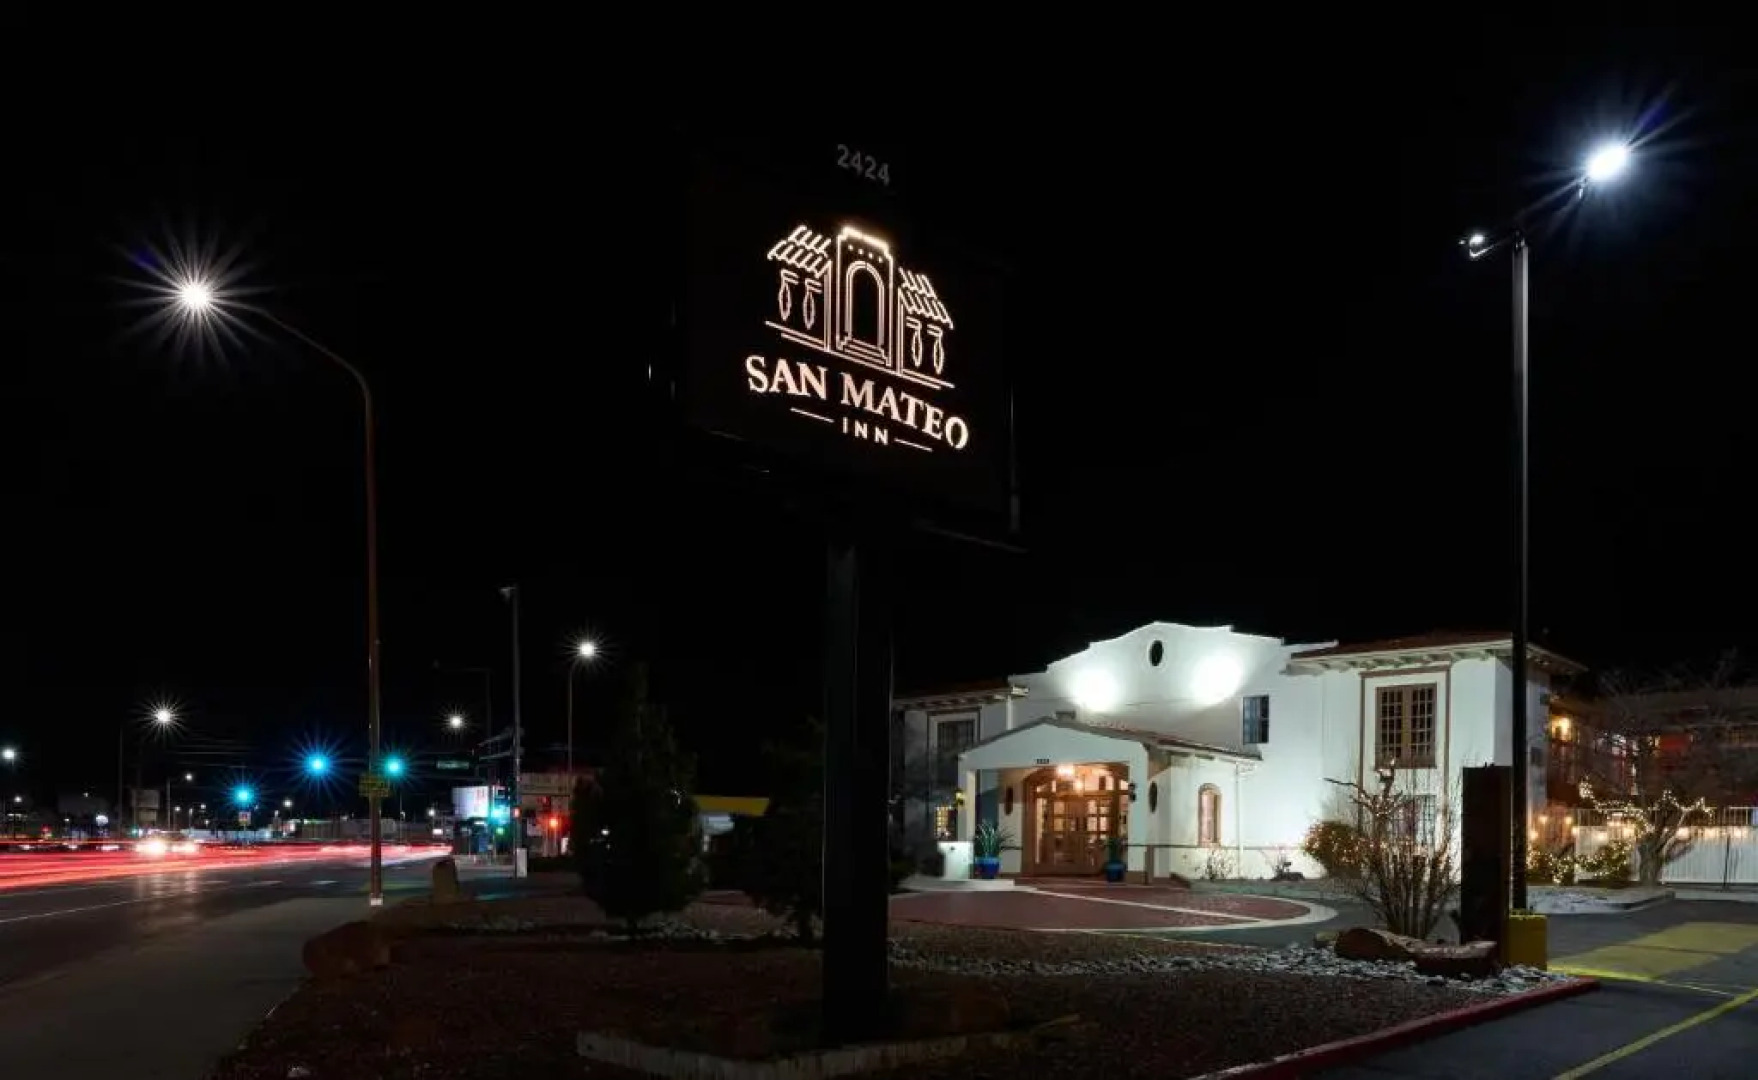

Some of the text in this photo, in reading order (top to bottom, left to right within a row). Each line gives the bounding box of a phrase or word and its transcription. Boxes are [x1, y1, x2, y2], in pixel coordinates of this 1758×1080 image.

[836, 143, 891, 187] 2424
[744, 354, 969, 450] SAN MATEO
[842, 416, 889, 446] INN
